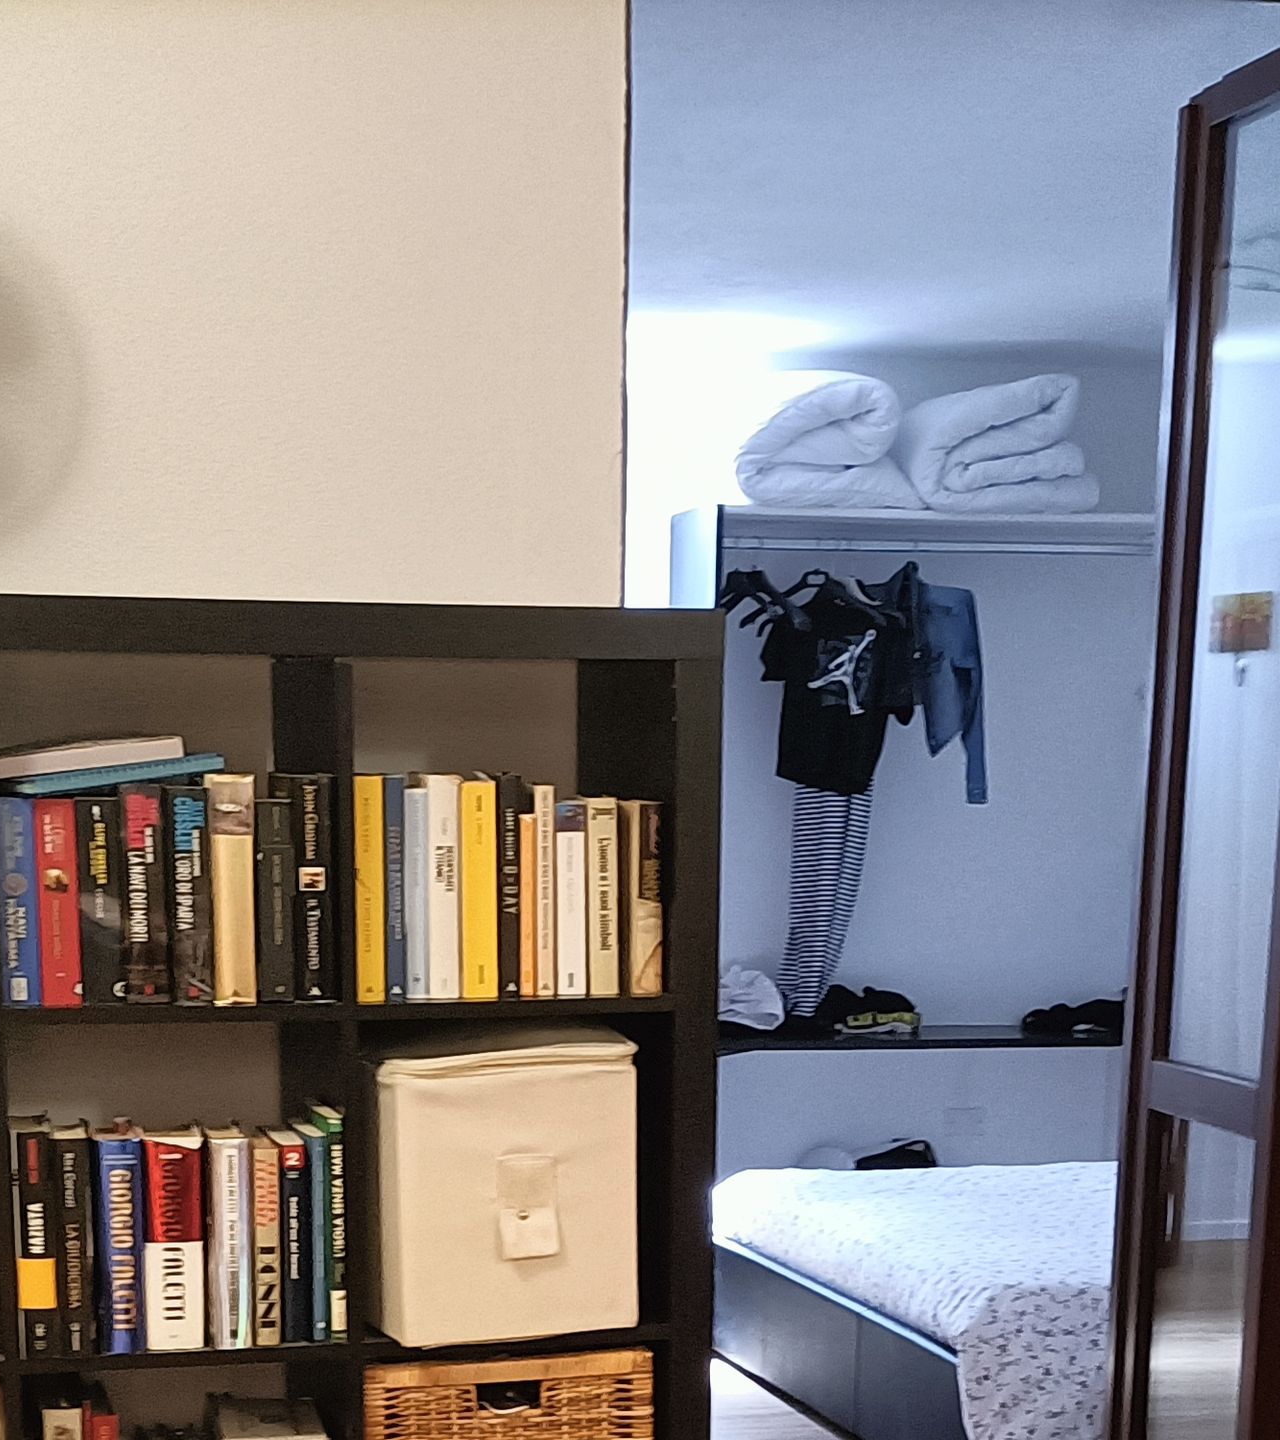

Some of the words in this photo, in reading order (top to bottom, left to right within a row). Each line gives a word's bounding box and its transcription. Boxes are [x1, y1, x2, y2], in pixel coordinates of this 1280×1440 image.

[127, 852, 146, 864] LA
[129, 866, 147, 891] NAVE
[176, 882, 192, 893] DI
[130, 892, 148, 908] DEI
[176, 895, 194, 930] SPARTA
[130, 910, 149, 942] MORTI
[330, 1144, 345, 1175] MARE
[109, 1169, 135, 1248] GIORGIO
[331, 1179, 346, 1214] SENZA
[111, 1254, 136, 1330] FALETTI
[161, 1247, 186, 1321] FALETTI
